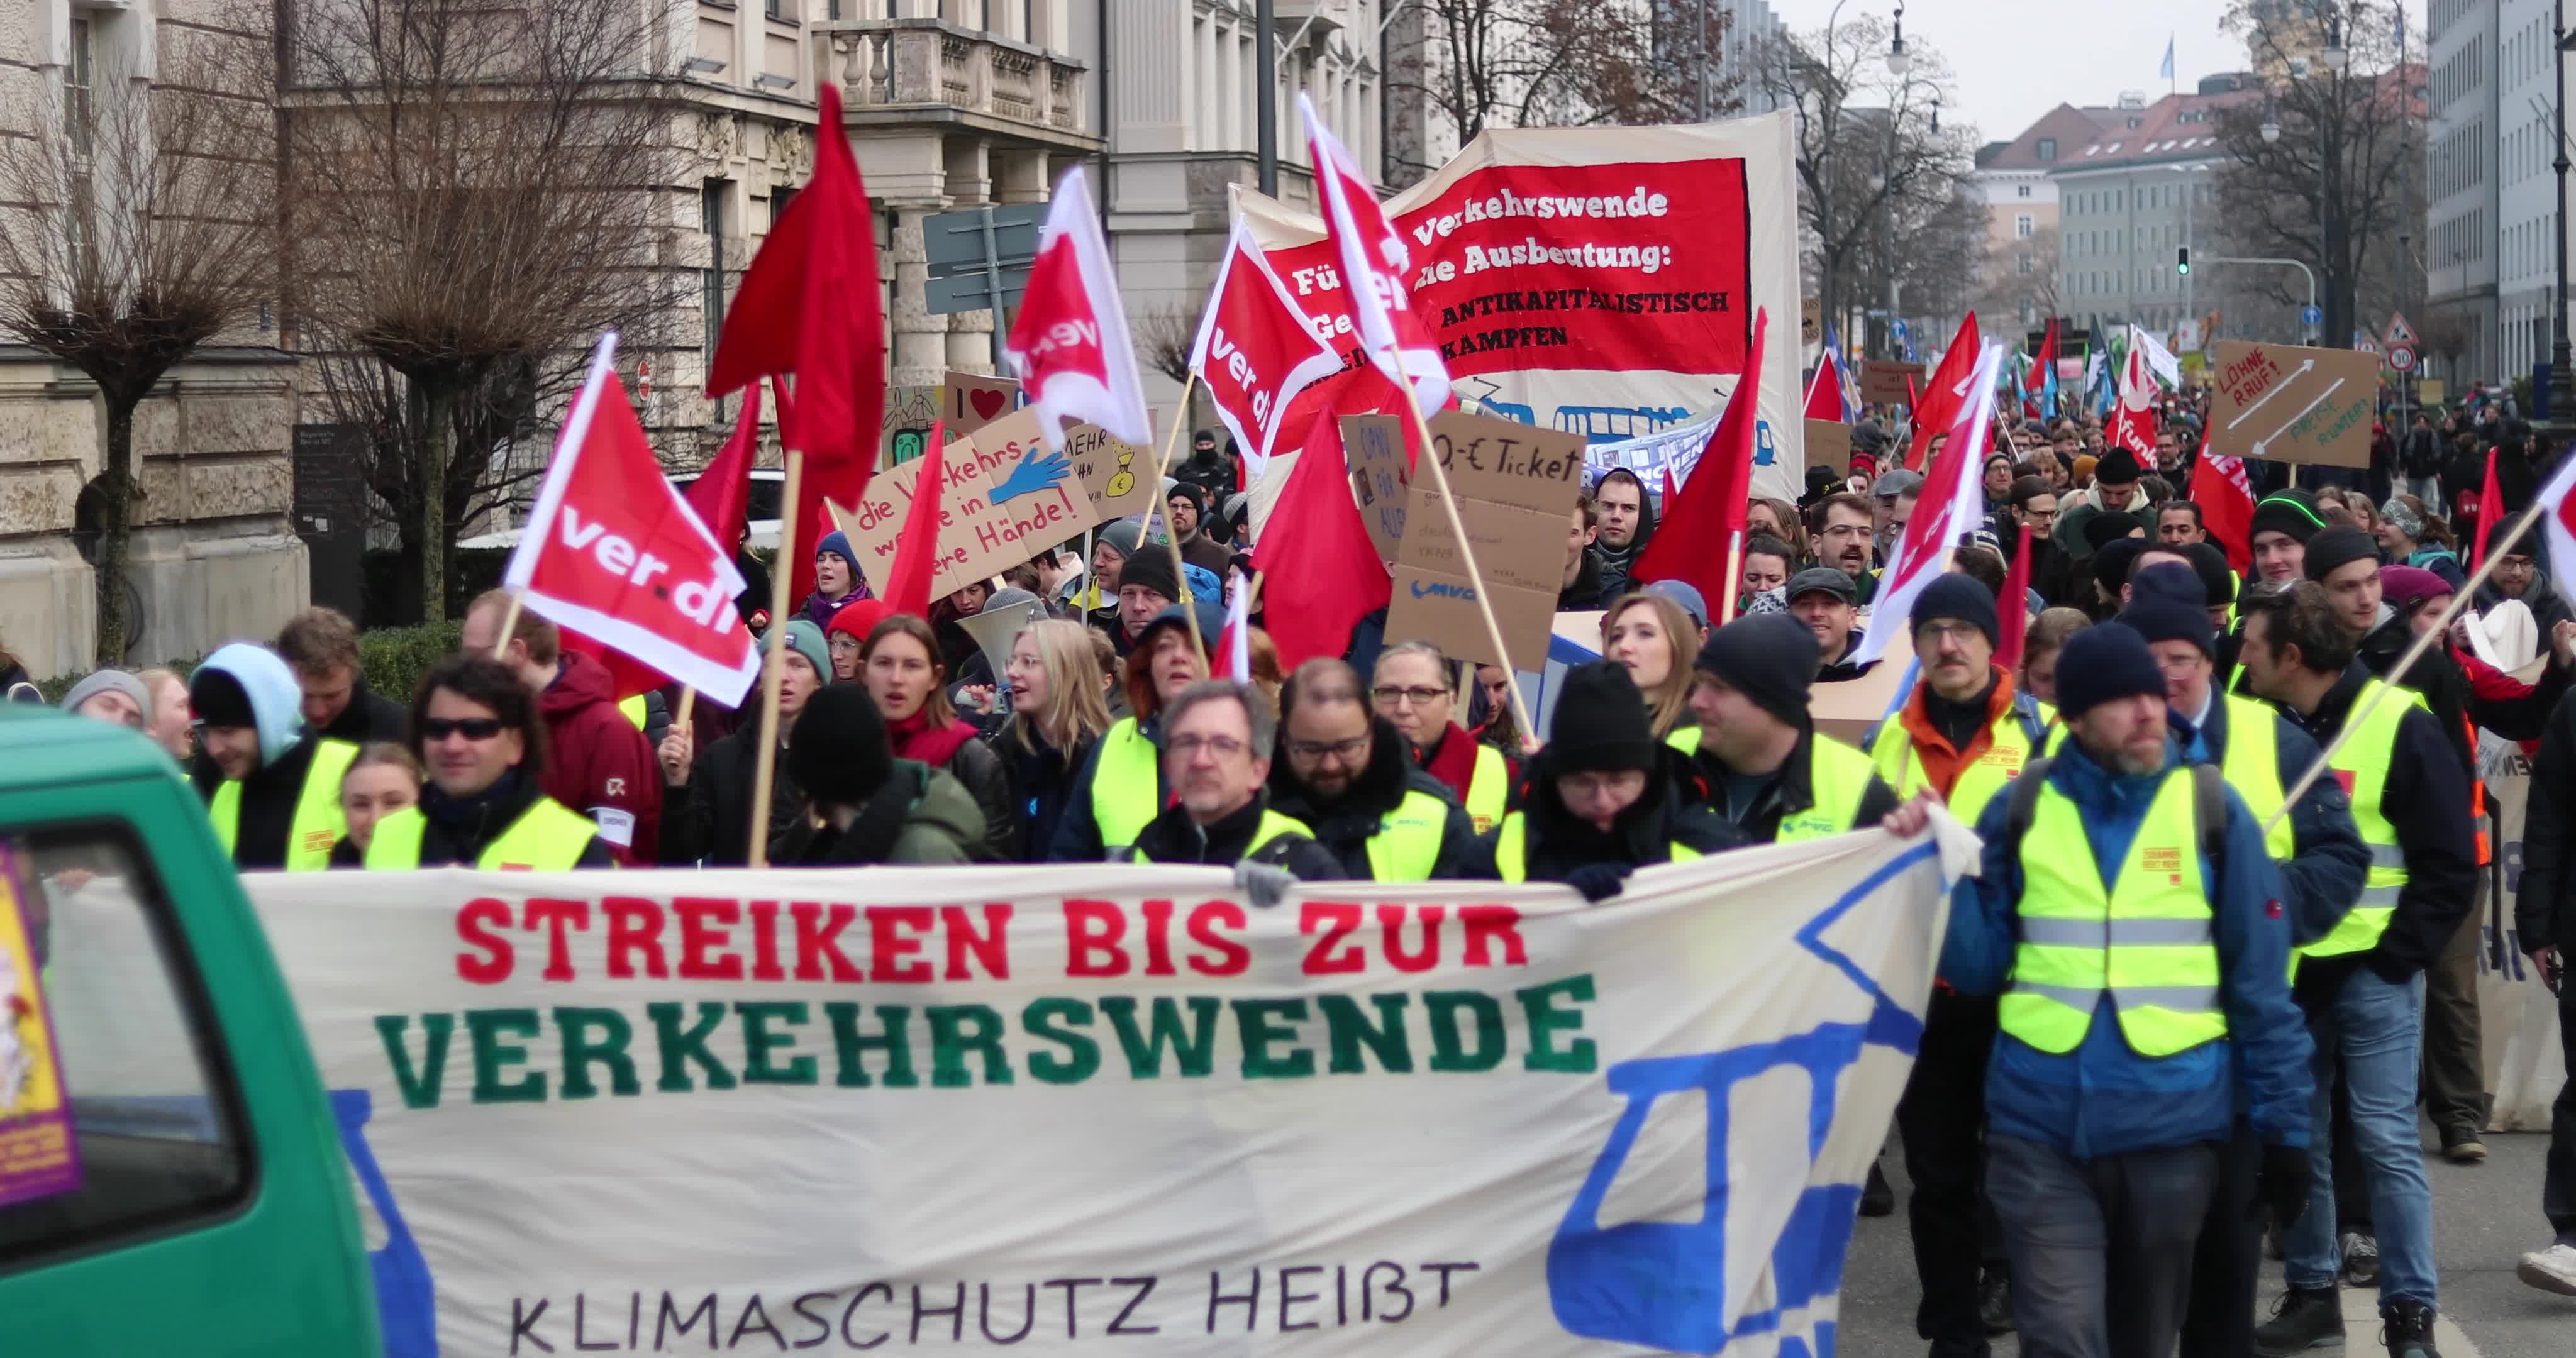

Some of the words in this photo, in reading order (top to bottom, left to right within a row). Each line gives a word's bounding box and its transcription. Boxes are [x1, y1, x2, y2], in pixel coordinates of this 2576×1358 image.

[1413, 185, 1668, 246] Verkehrswende
[1463, 236, 1671, 274] Ausbeutung:
[1292, 264, 1341, 296] Fü
[1312, 314, 1353, 340] Ge
[1441, 288, 1729, 328] ANTIKAPITALISTISCH
[1441, 326, 1568, 362] KÄMPFEN
[2218, 346, 2265, 394] LÖHNE
[2234, 360, 2281, 406] RAUF!
[1496, 438, 1580, 482] Ticket
[859, 500, 896, 531] die
[956, 495, 985, 516] in
[975, 482, 1078, 554] Hände!
[562, 504, 740, 634] ver.di
[455, 896, 1014, 985] STREIKEN
[1063, 899, 1251, 978] BIS
[1299, 900, 1529, 975] ZUR
[374, 974, 1597, 1109] VERKEHRSWENDE
[510, 1276, 1160, 1357] KLIMASCHUTZ
